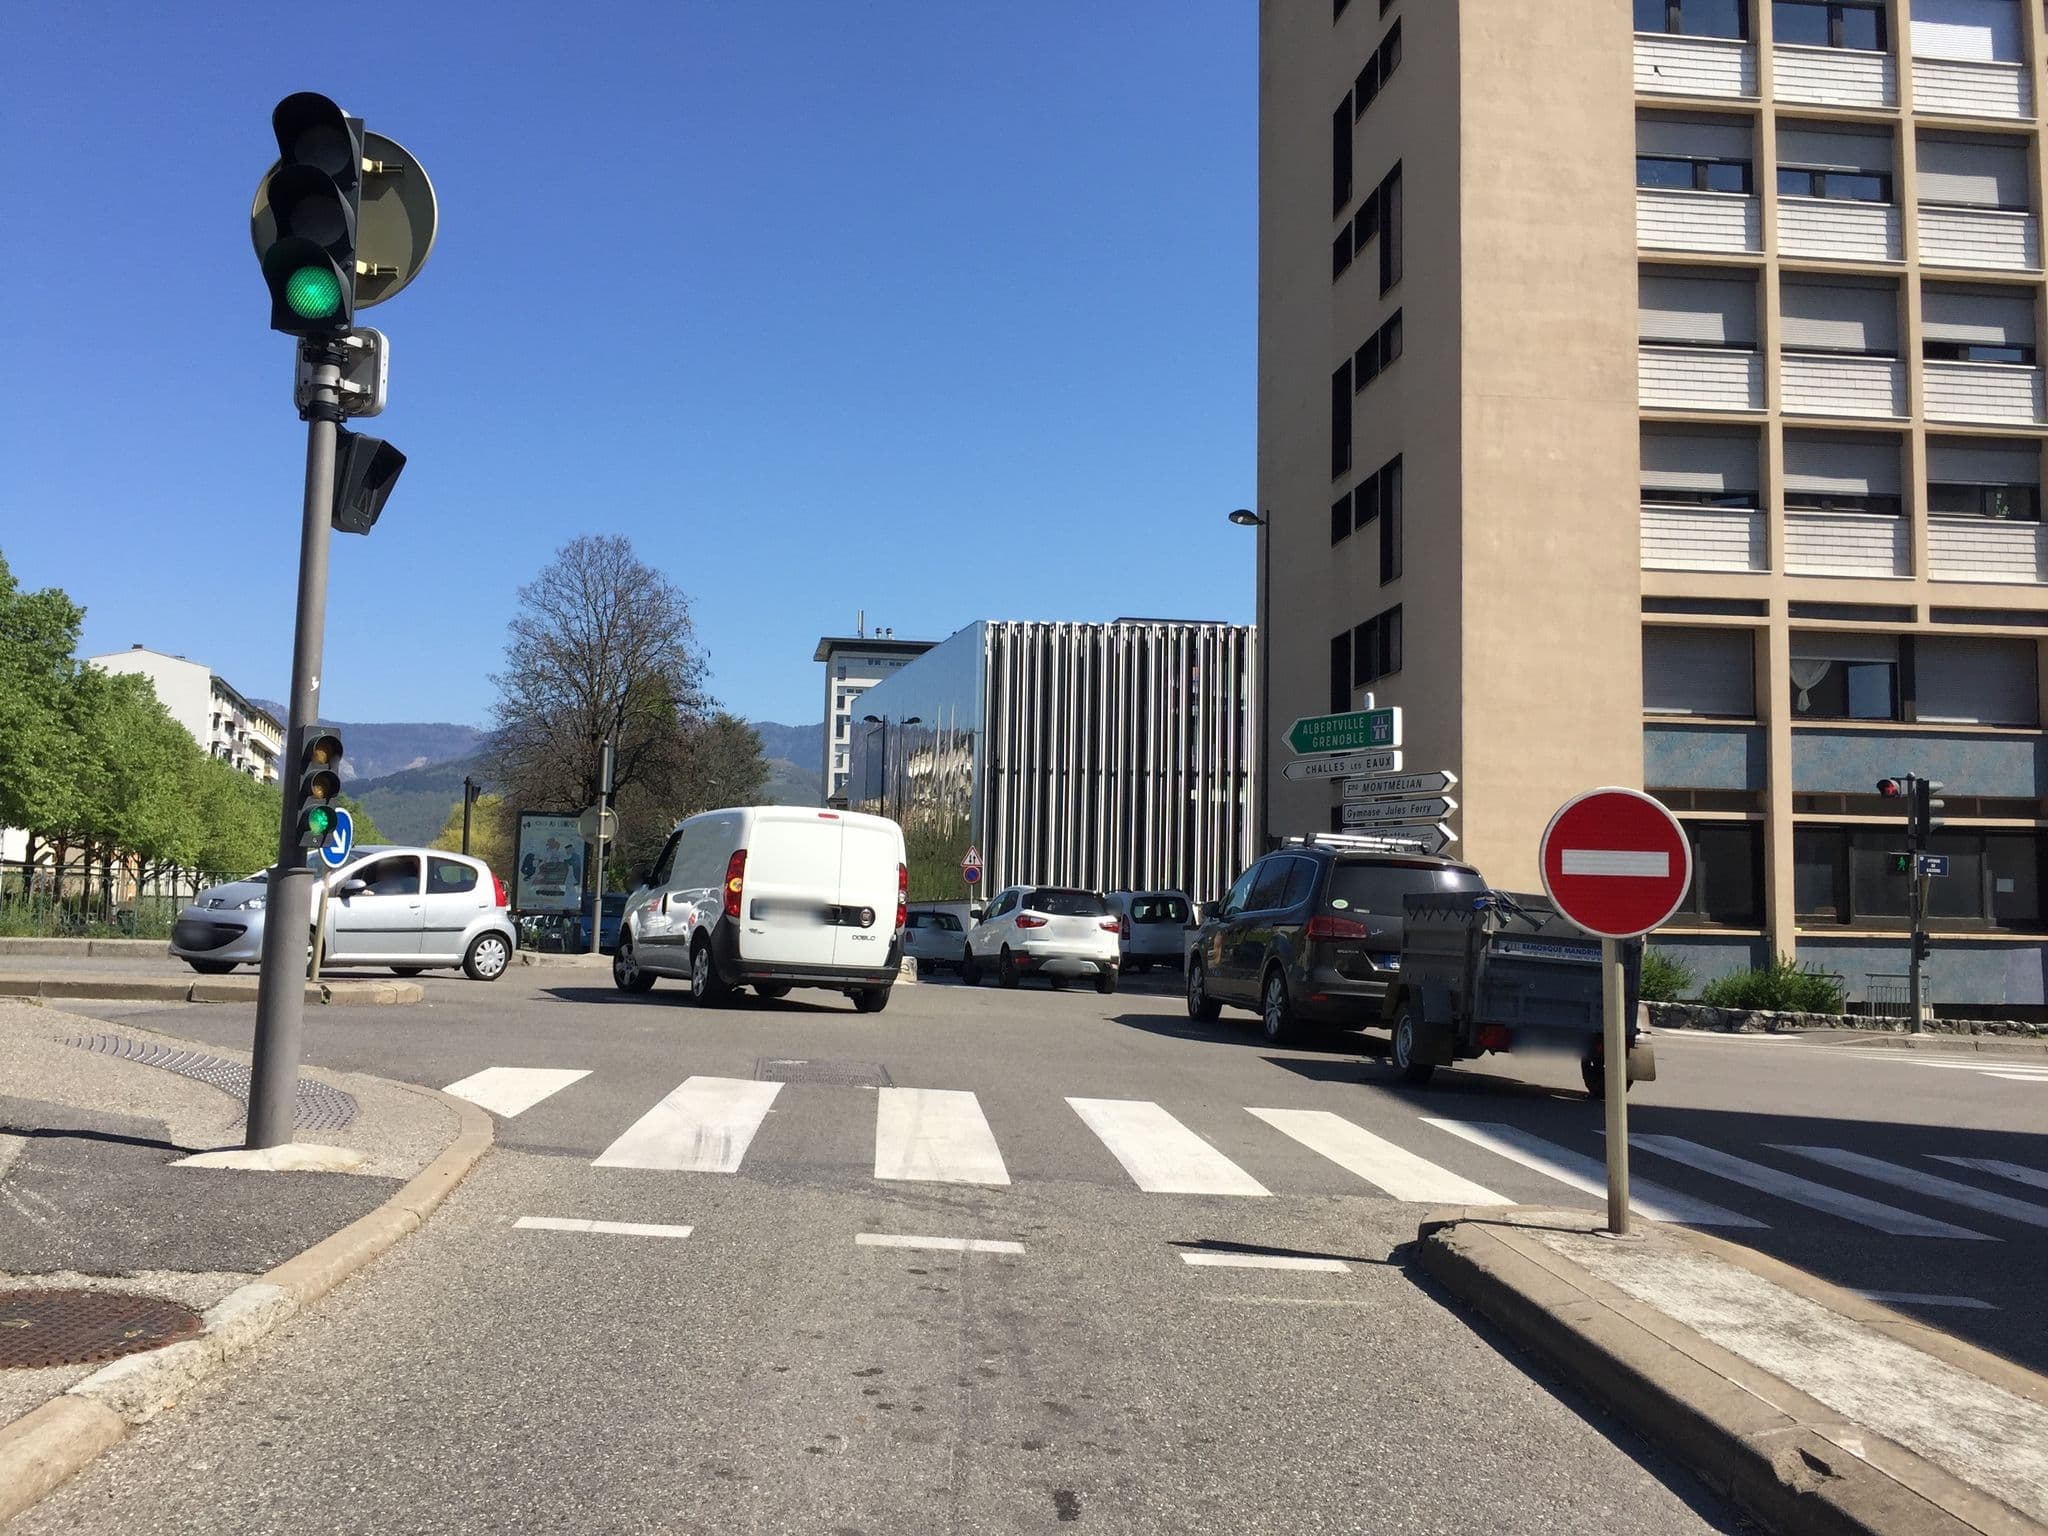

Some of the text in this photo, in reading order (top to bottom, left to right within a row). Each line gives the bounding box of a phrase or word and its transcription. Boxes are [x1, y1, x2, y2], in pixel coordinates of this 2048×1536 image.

[1302, 717, 1364, 735] ALBERTVILLE
[1313, 732, 1364, 748] GRENOBLE
[1305, 762, 1345, 774] CHALLES
[1366, 757, 1391, 768] EAUX
[1346, 804, 1432, 819] Gymnase Jules Ferry
